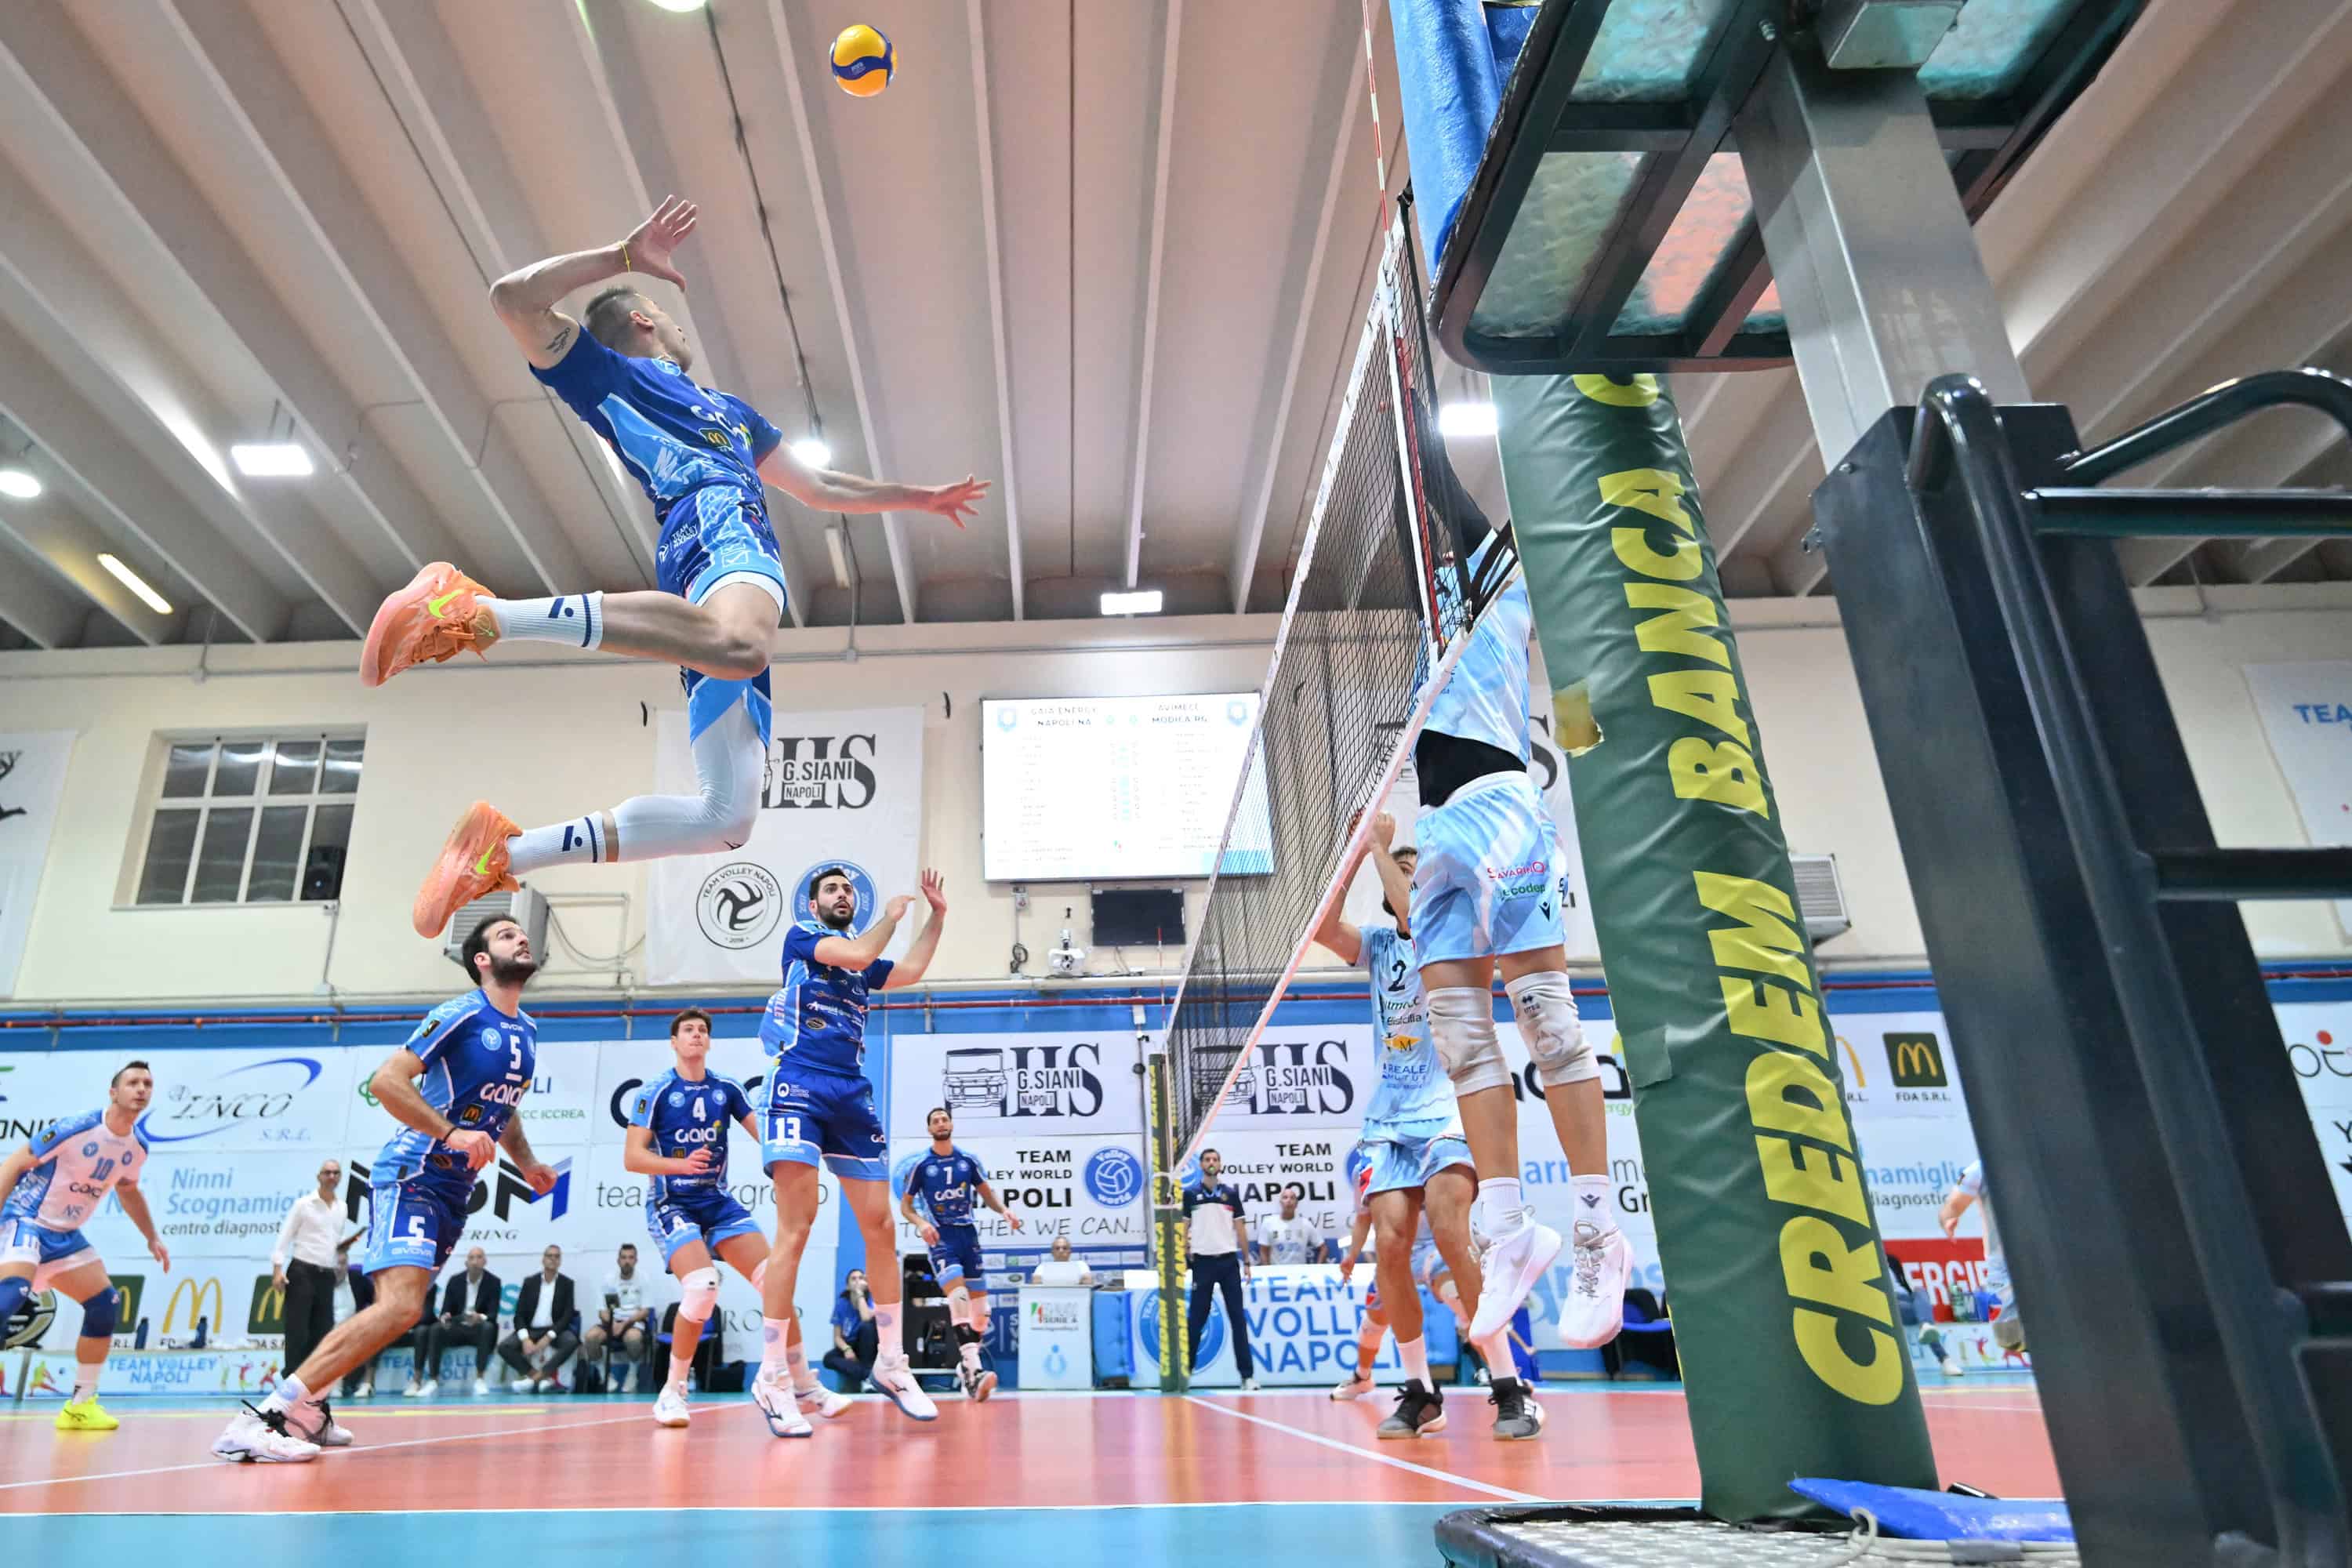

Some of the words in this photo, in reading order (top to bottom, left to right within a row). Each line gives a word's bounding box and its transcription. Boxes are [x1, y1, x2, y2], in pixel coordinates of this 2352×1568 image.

[1598, 468, 1770, 821] BANCA
[784, 760, 853, 782] G.SIANI
[785, 786, 821, 799] NAPOLI
[719, 867, 753, 879] VOLLEY
[1388, 960, 1406, 992] 2
[510, 1035, 522, 1070] 5
[1018, 1070, 1080, 1090] G.SIANI
[1266, 1065, 1330, 1087] G.SIANI
[1021, 1094, 1054, 1106] NAPOLI
[1270, 1091, 1305, 1105] NAPOLI
[692, 1097, 707, 1123] 4
[775, 1116, 801, 1146] 13
[1693, 870, 1904, 1405] CREDEM
[1016, 1150, 1072, 1163] TEAM
[1275, 1142, 1331, 1157] TEAM
[89, 1156, 114, 1181] 10
[172, 1167, 234, 1190] Ninni
[1020, 1168, 1073, 1180] WORLD
[1279, 1162, 1334, 1174] WORLD
[167, 1190, 309, 1220] Scognamig
[162, 1221, 211, 1236] centro
[214, 1220, 281, 1239] diagnost
[408, 1216, 426, 1246] 5
[1035, 1217, 1072, 1236] WE
[1249, 1276, 1354, 1303] TEAM
[108, 1357, 153, 1371] TEAM
[156, 1357, 218, 1372] VOLLEY
[129, 1371, 191, 1385] NAPOLI
